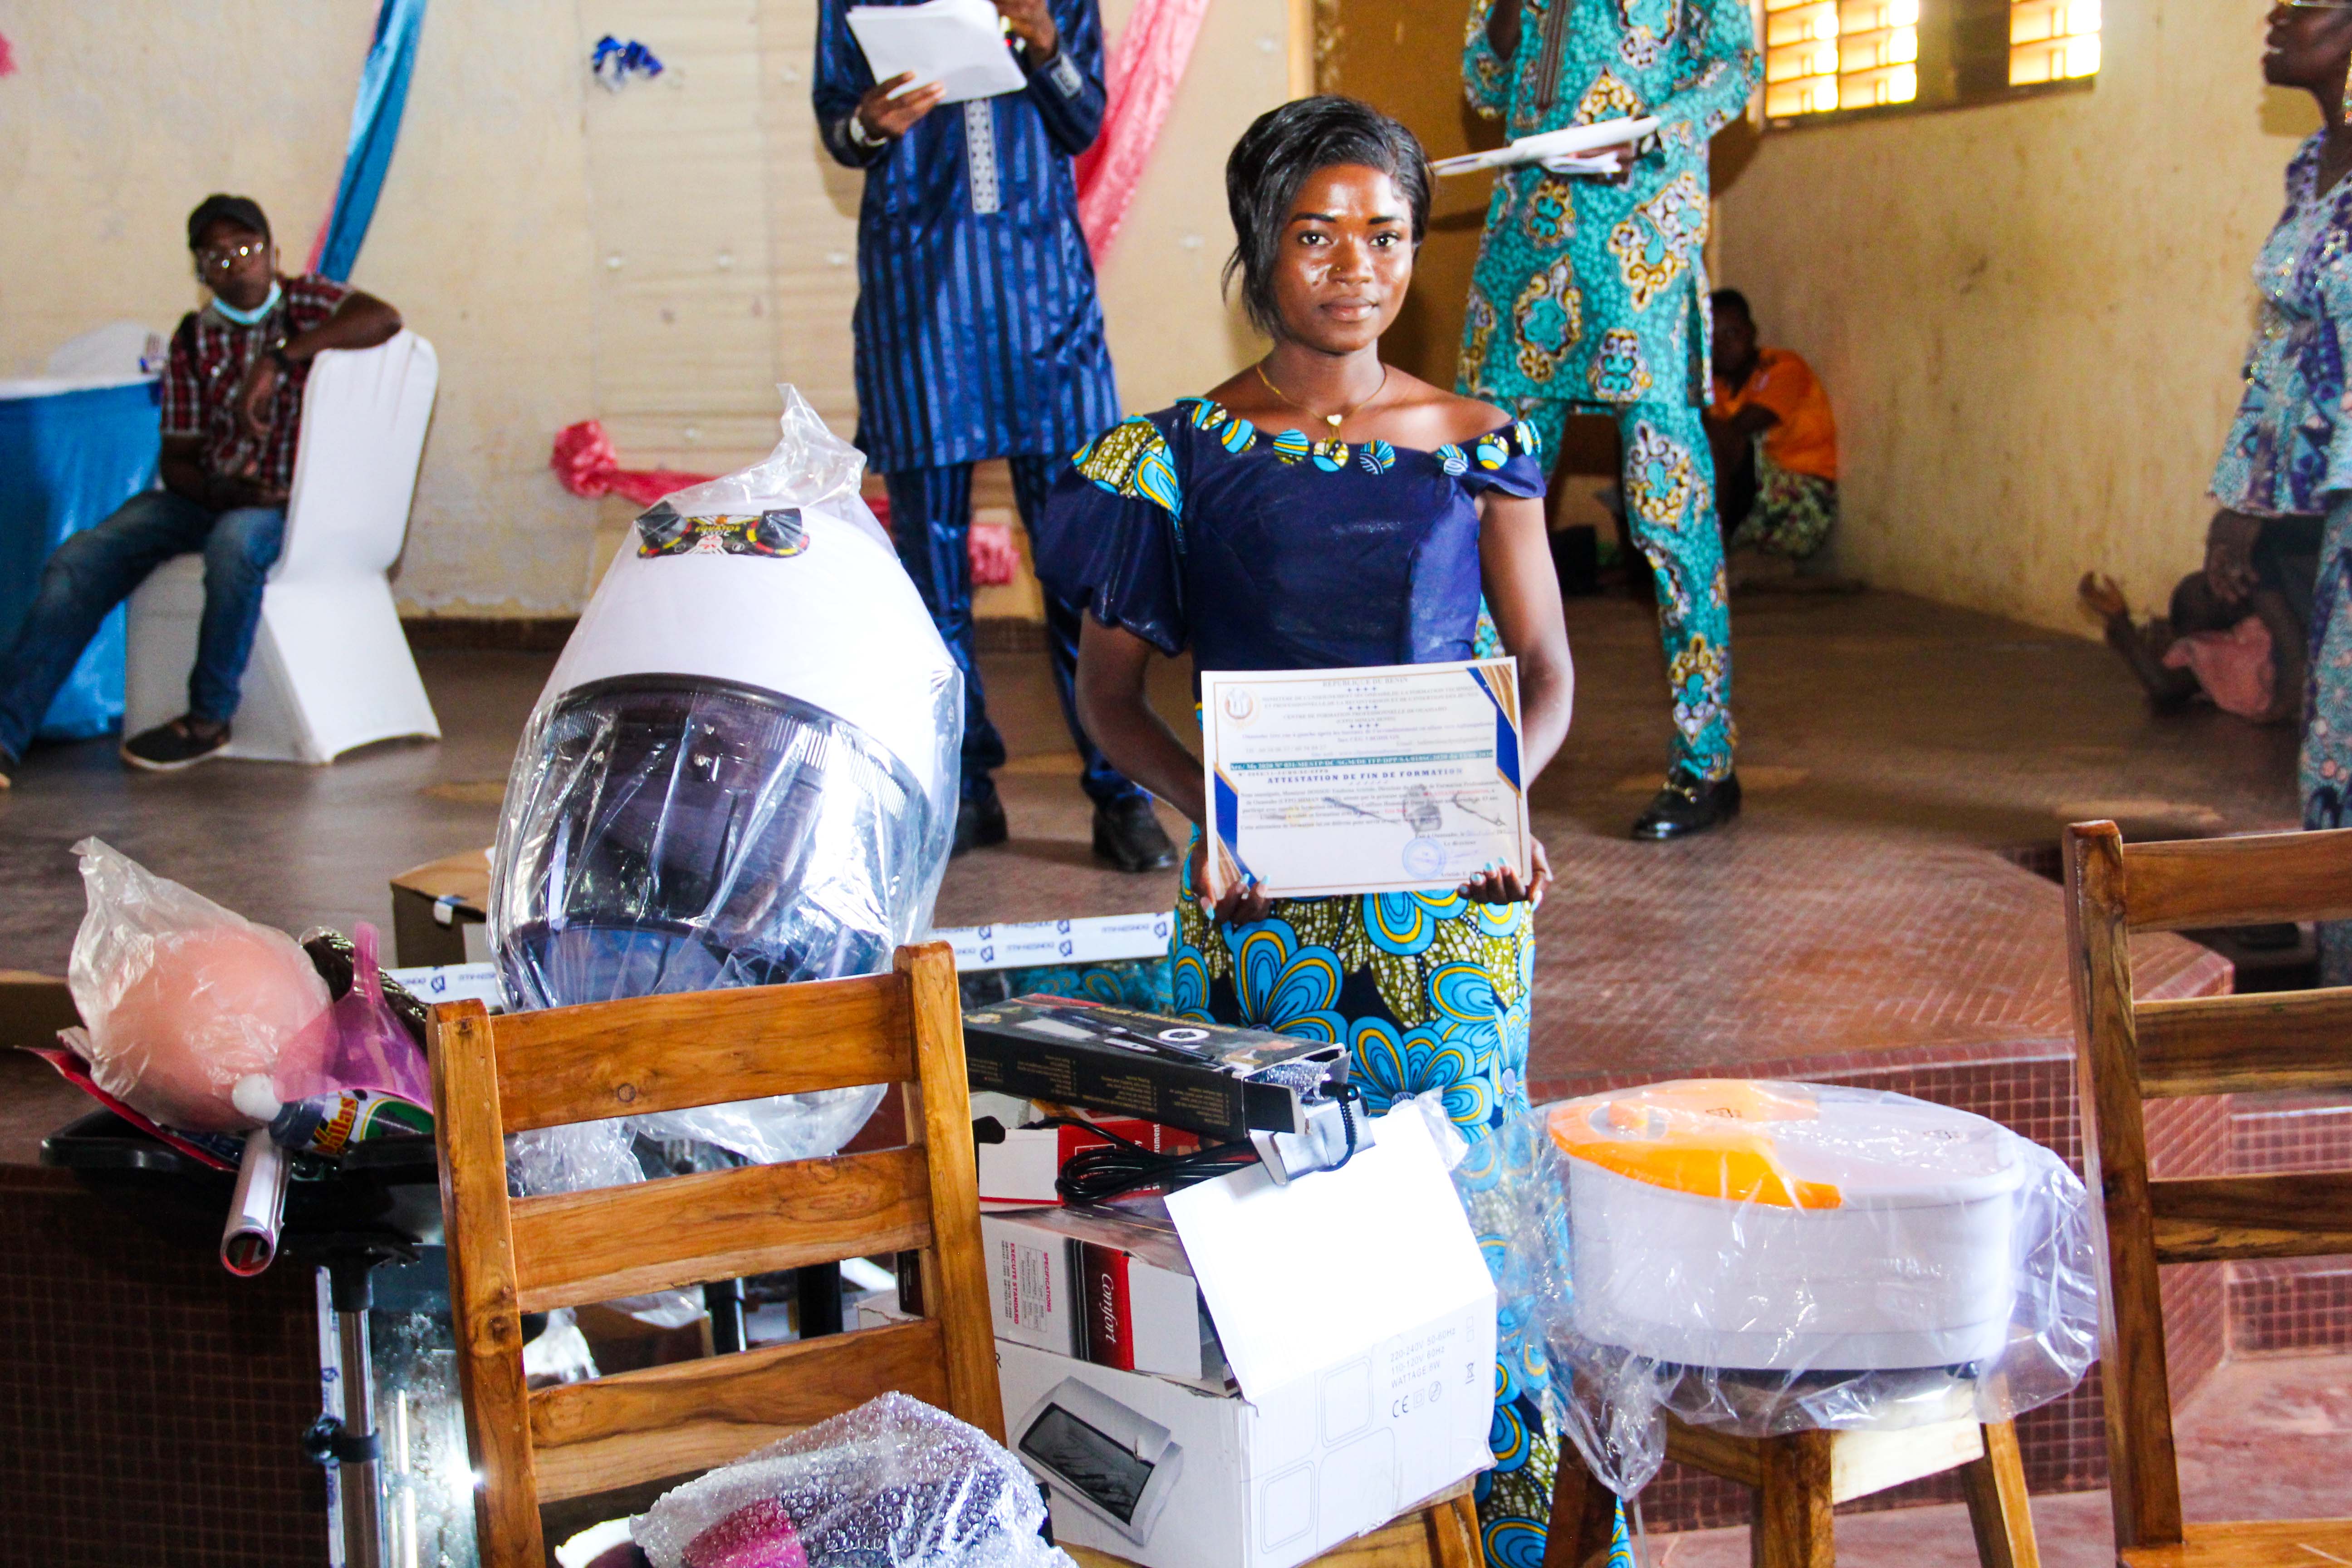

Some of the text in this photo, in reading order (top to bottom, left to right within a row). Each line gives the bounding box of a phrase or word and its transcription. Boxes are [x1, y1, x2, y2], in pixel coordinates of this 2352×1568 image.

[1268, 774, 1338, 784] ATTESTATION
[1400, 768, 1463, 777] FORMATION
[1099, 1274, 1117, 1343] Comfort
[1390, 1340, 1424, 1362] 220-240V
[1391, 1354, 1424, 1375] 110-120V
[1391, 1366, 1426, 1388] WATTAGE
[1392, 1395, 1409, 1418] CE
